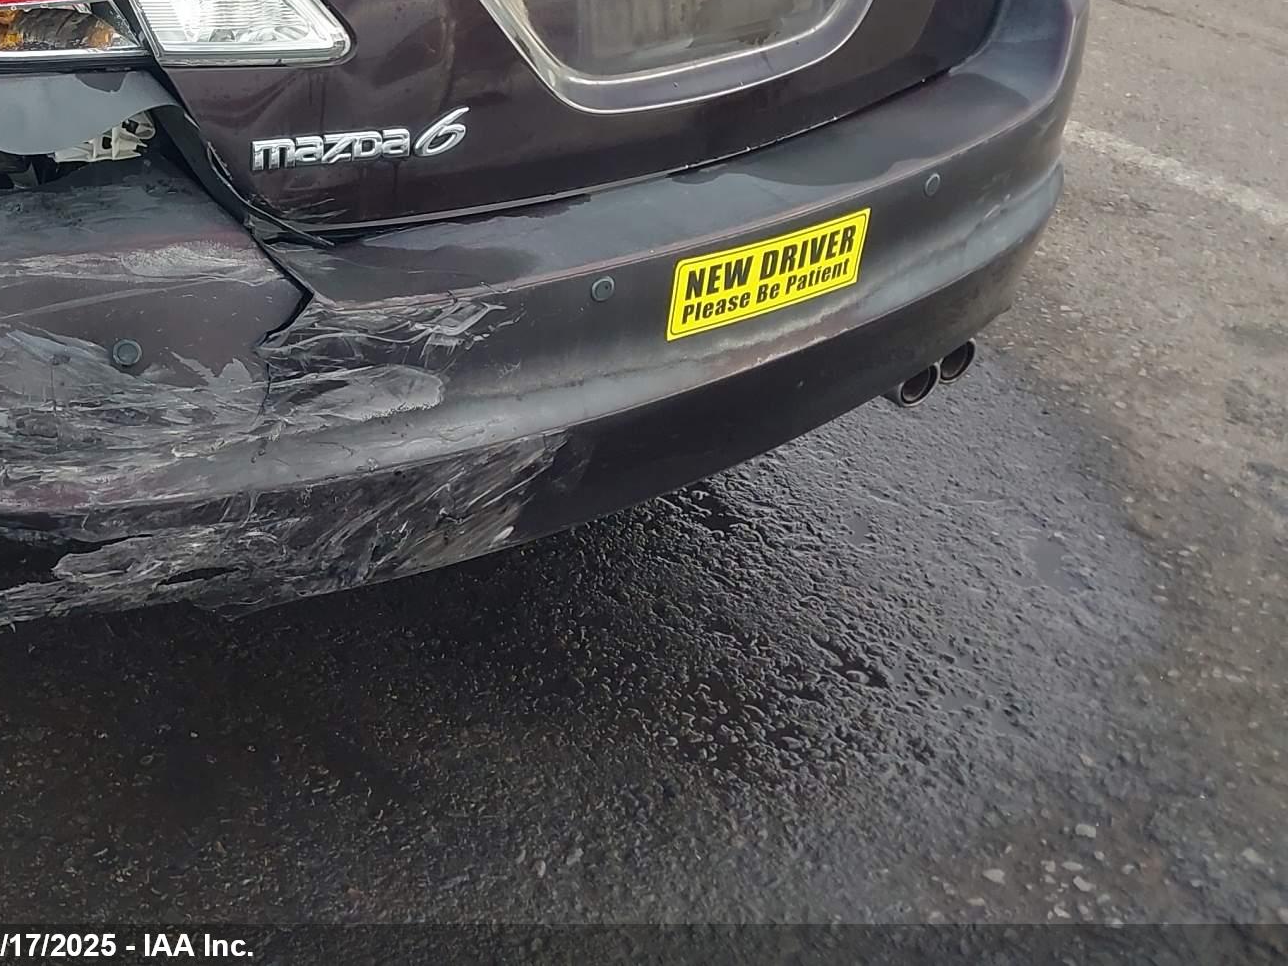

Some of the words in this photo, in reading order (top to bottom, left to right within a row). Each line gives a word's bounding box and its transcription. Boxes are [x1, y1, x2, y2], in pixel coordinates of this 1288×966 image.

[414, 106, 469, 157] 6
[681, 291, 751, 325] Please
[756, 283, 780, 304] Be
[785, 258, 850, 294] Patient
[685, 255, 753, 301] NEW
[760, 224, 857, 280] DRIVER
